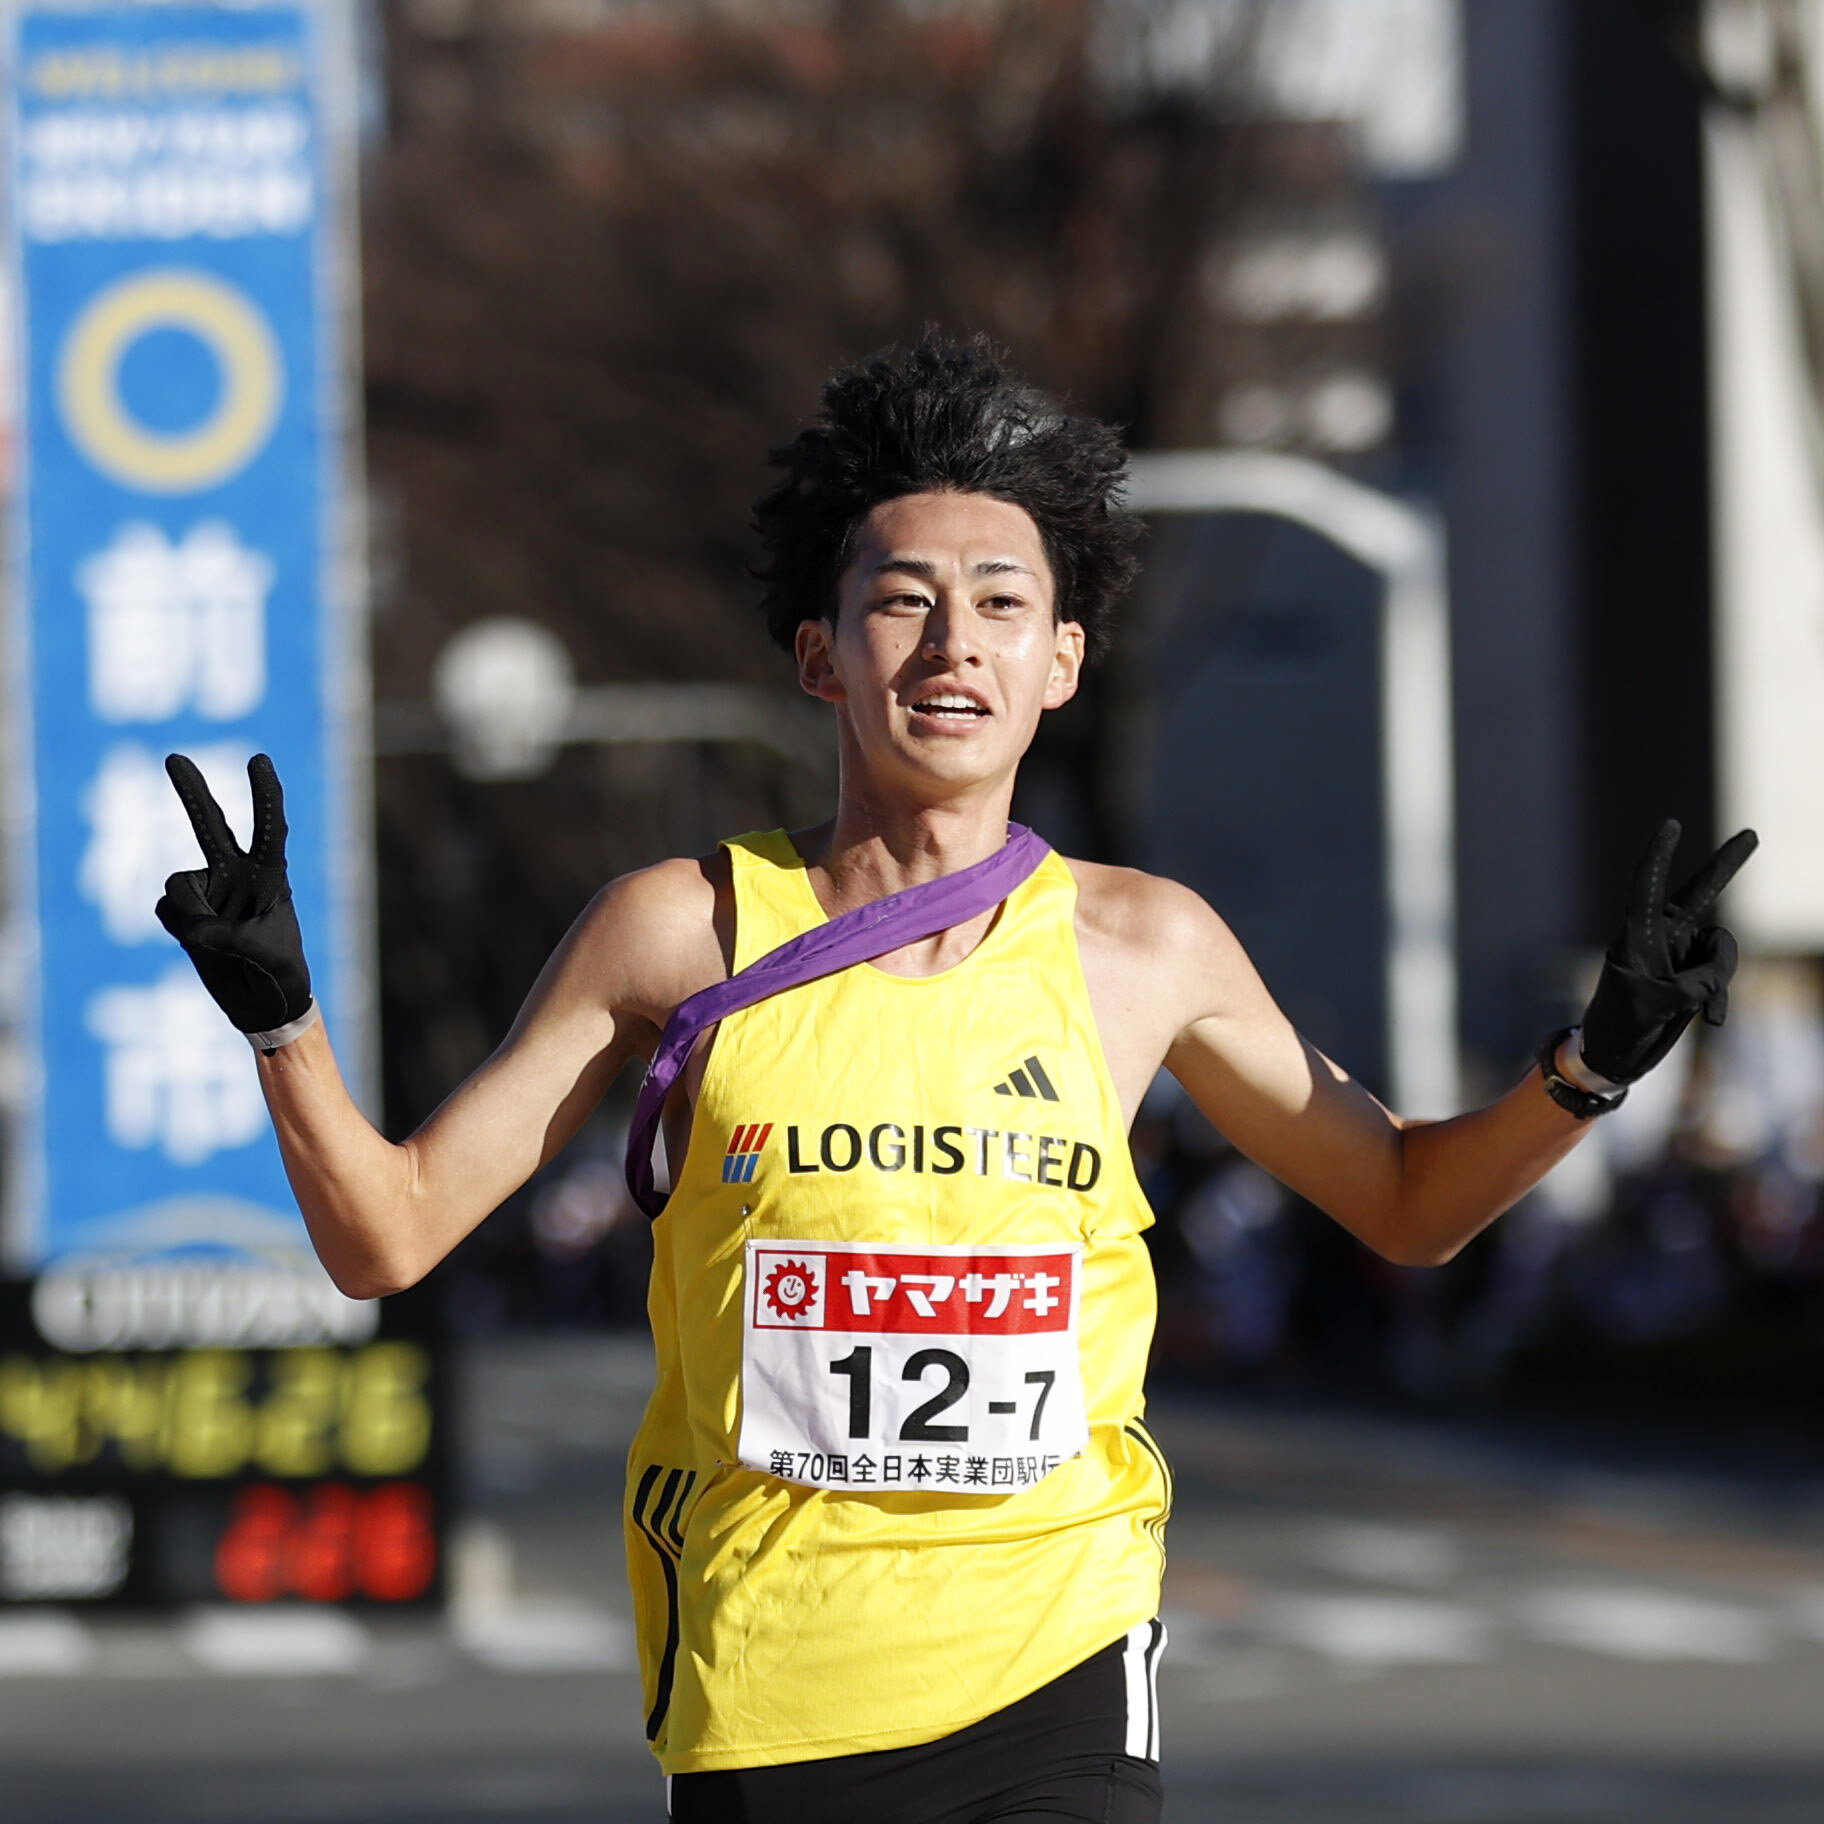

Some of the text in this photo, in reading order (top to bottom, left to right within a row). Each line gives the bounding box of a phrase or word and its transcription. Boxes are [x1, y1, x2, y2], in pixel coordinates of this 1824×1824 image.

[787, 1123, 1102, 1193] LOGISTEED
[841, 1270, 1061, 1318] ヤマザキ
